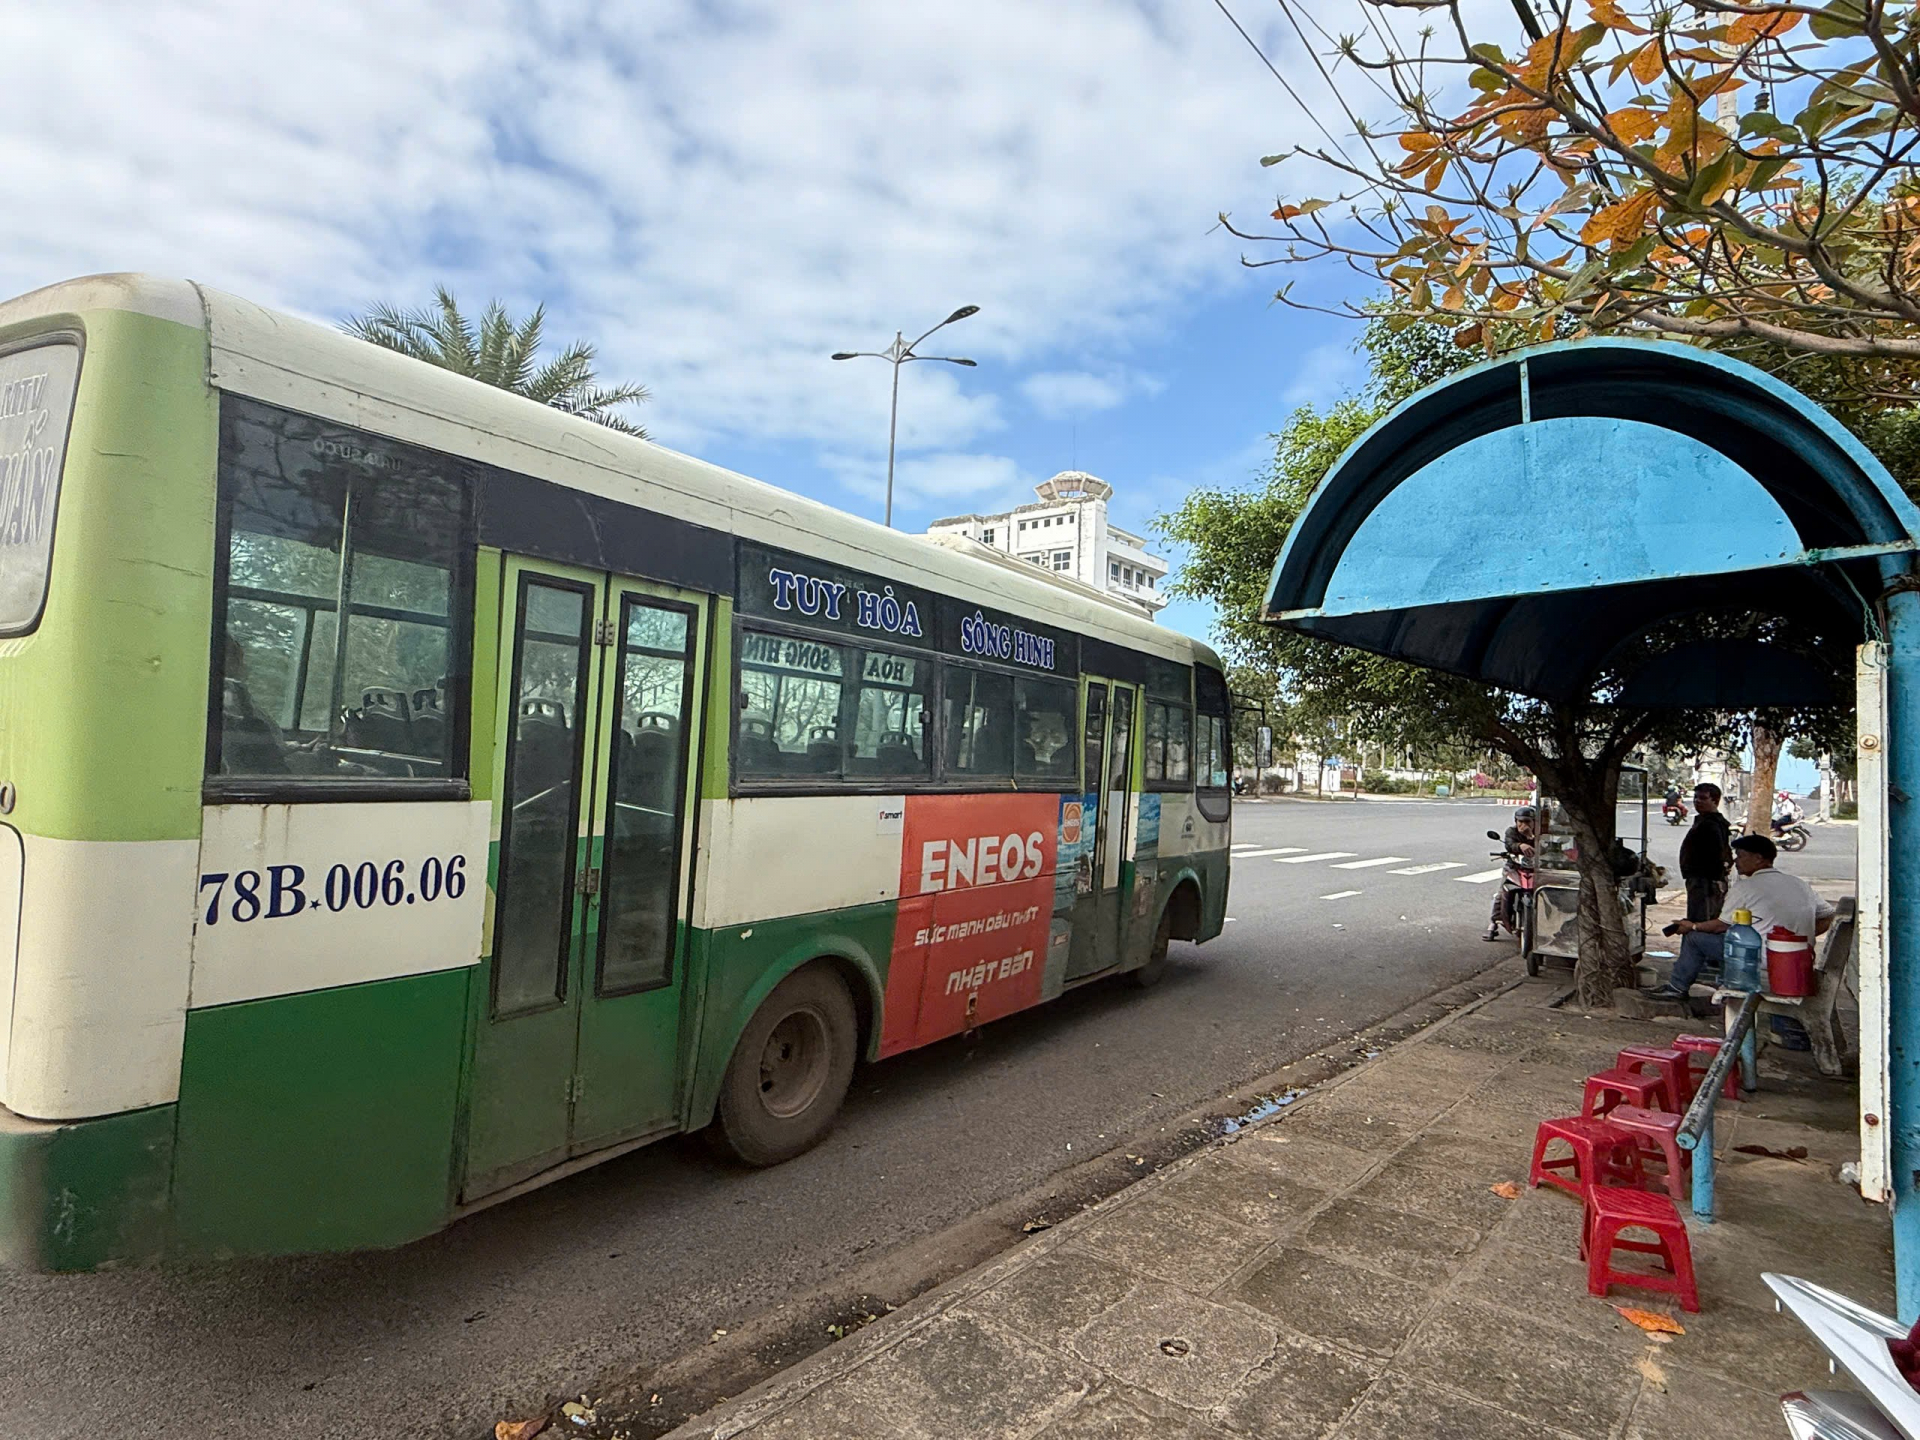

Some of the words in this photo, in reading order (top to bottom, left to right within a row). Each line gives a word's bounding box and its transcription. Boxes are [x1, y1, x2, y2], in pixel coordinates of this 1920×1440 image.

[769, 568, 845, 620] TUY
[857, 585, 922, 637] HÒA
[961, 610, 1011, 659] SÔNG
[1014, 630, 1054, 670] HINH
[920, 831, 1044, 894] ENEOS
